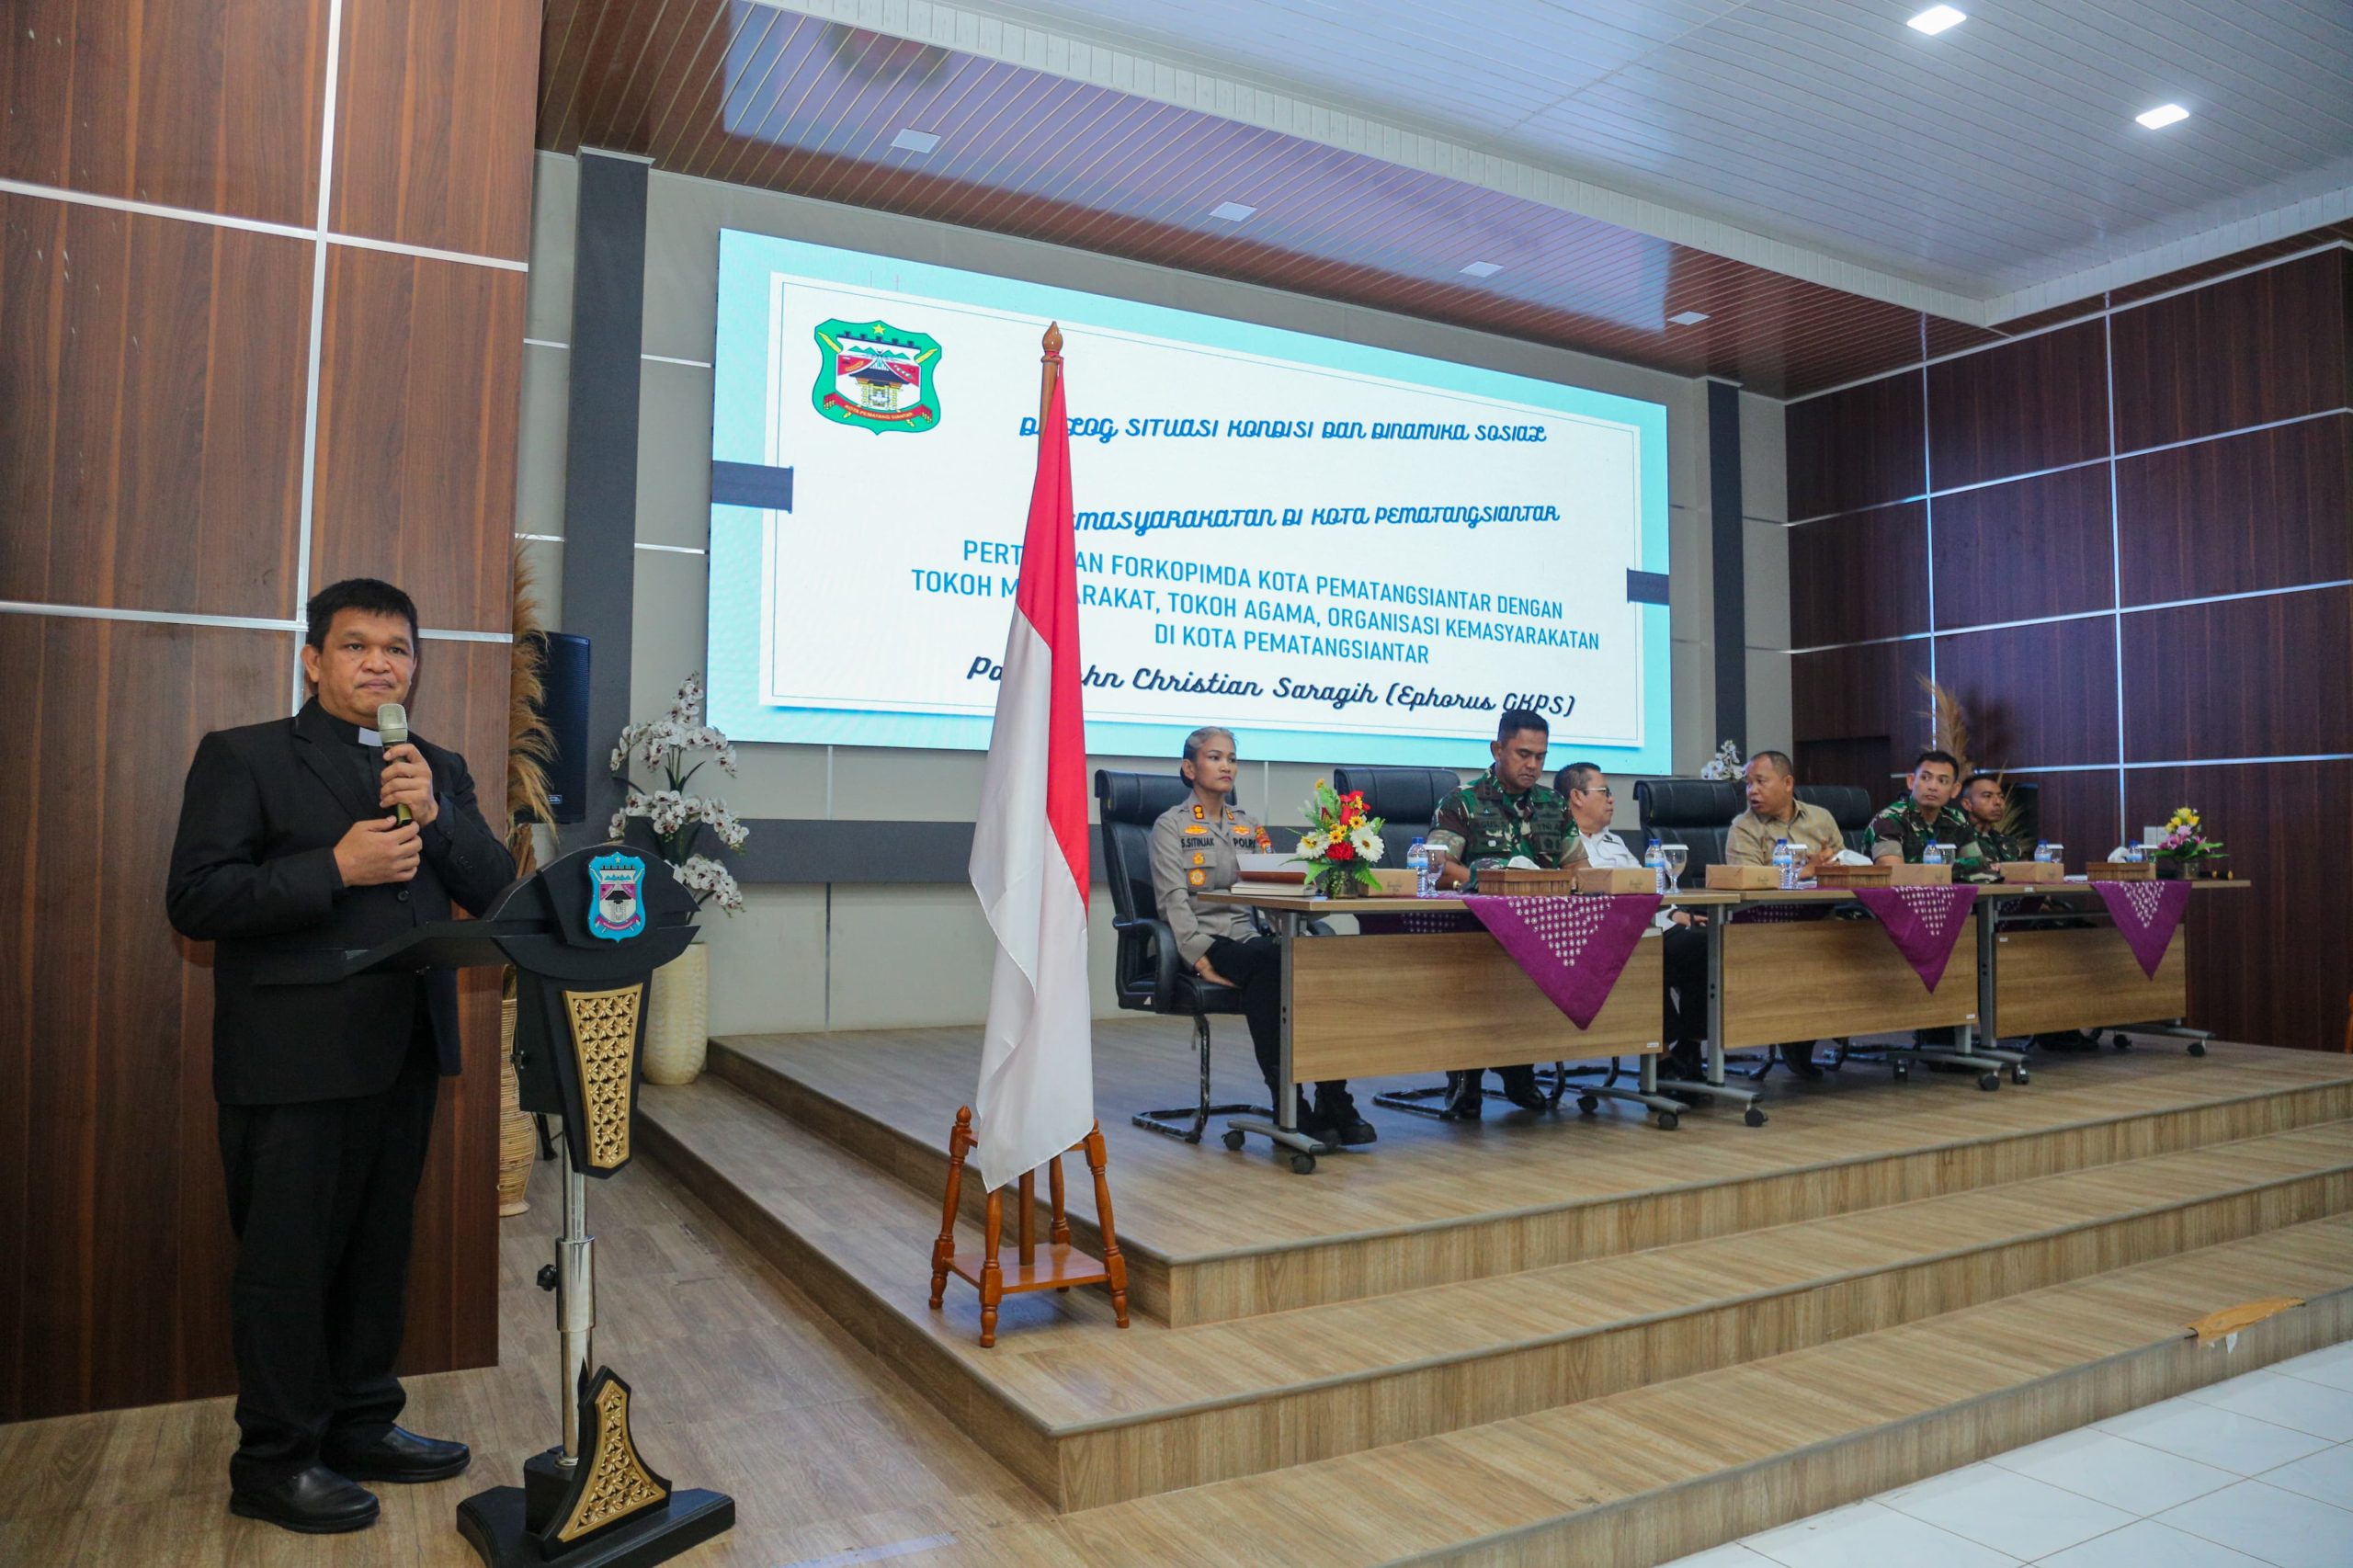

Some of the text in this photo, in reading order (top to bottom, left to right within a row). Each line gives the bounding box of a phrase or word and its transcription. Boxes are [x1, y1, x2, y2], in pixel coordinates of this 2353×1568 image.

[1019, 417, 1547, 444] DLOG SITUASI KONDISI DAN DINAMIKA SOSIAL
[1074, 506, 1560, 537] MASYARAKATAN DI KOTA PEMATANGSIANTAR
[964, 540, 1563, 619] PERTAN FORKOPIMDA KOTA PEMATANGSIANTAR DENGAN
[912, 569, 1599, 651] TOKOH MRAKAT, TOKOH AGAMA, ORGANISASI KEMASYARAKATAN
[1155, 623, 1429, 664] DI KOTA PEMATANGSIANTAR
[1082, 665, 1124, 687] hn
[1132, 667, 1263, 696] Christian
[1273, 677, 1378, 710] Saragih
[1385, 682, 1496, 711] (Ephorus
[1502, 692, 1574, 717] GKPS)
